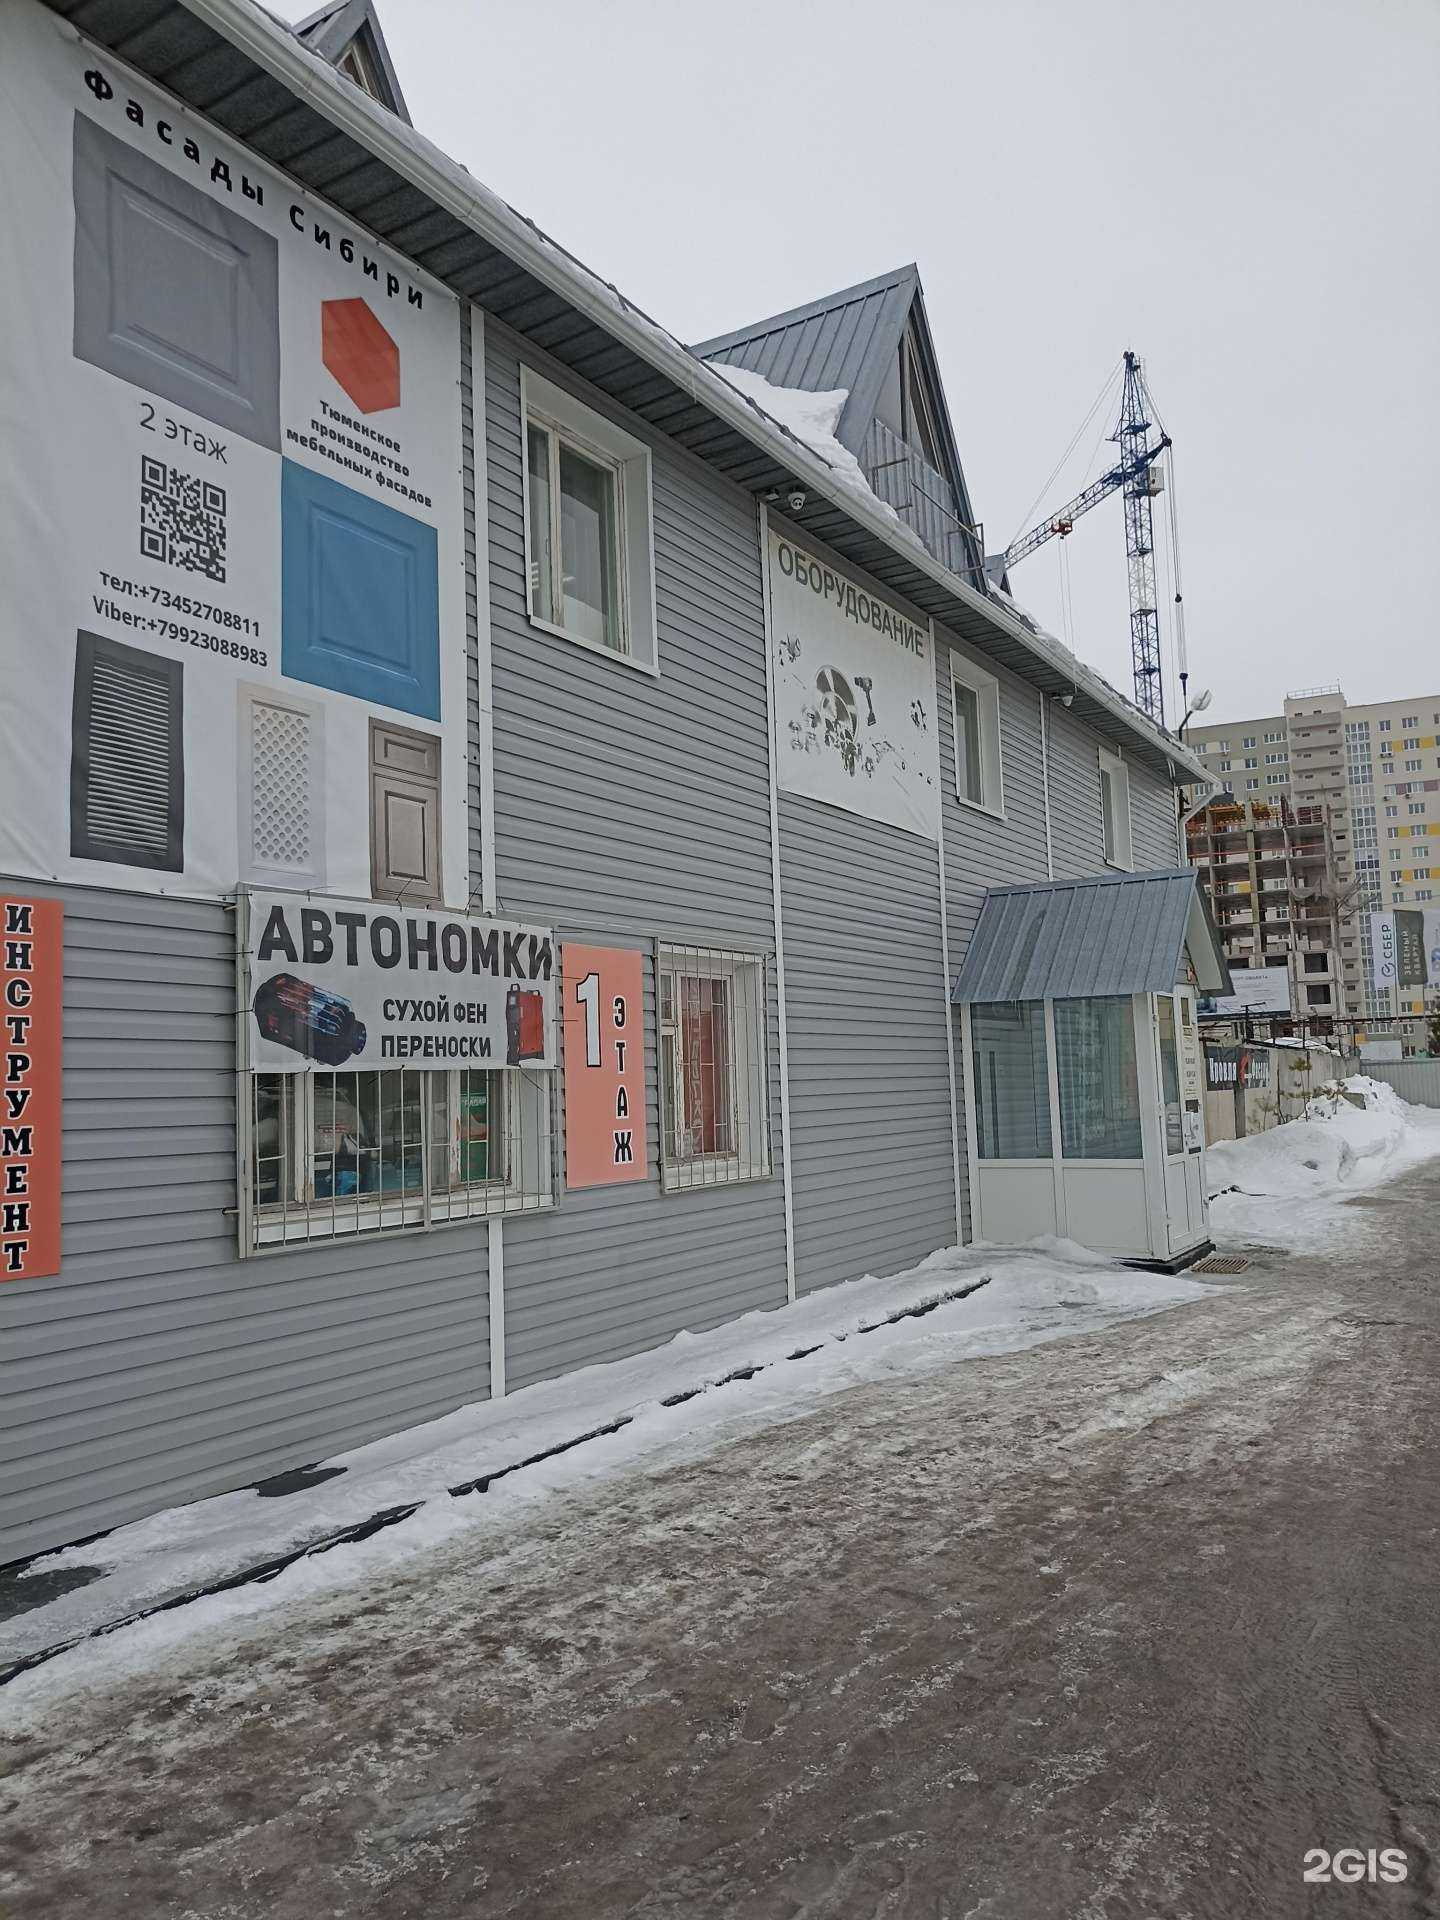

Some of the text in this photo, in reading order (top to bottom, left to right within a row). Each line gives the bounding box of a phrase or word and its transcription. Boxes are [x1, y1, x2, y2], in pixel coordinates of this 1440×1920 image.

[84, 70, 424, 310] Фасады Сибири
[139, 402, 228, 465] 2 этаж
[310, 418, 410, 478] производство
[319, 400, 402, 453] Тюменское
[286, 428, 432, 508] мебельных фасадов
[92, 596, 268, 668] Viber:+79923088983
[99, 571, 261, 638] тел:+73452708811
[778, 542, 925, 659] ОБОРУДОВАНИЕ
[257, 905, 554, 982] АВТОНОМКИ
[1381, 924, 1393, 959] СБЕР
[382, 994, 488, 1025] СУХОЙ ФЕН
[576, 972, 602, 1067] 1
[381, 1035, 492, 1058] ПЕРЕНОСКИ
[612, 995, 635, 1165] ЭТАЖ
[1209, 1057, 1237, 1084] Кровля
[1, 904, 33, 1273] ИНСТРУМЕНТ
